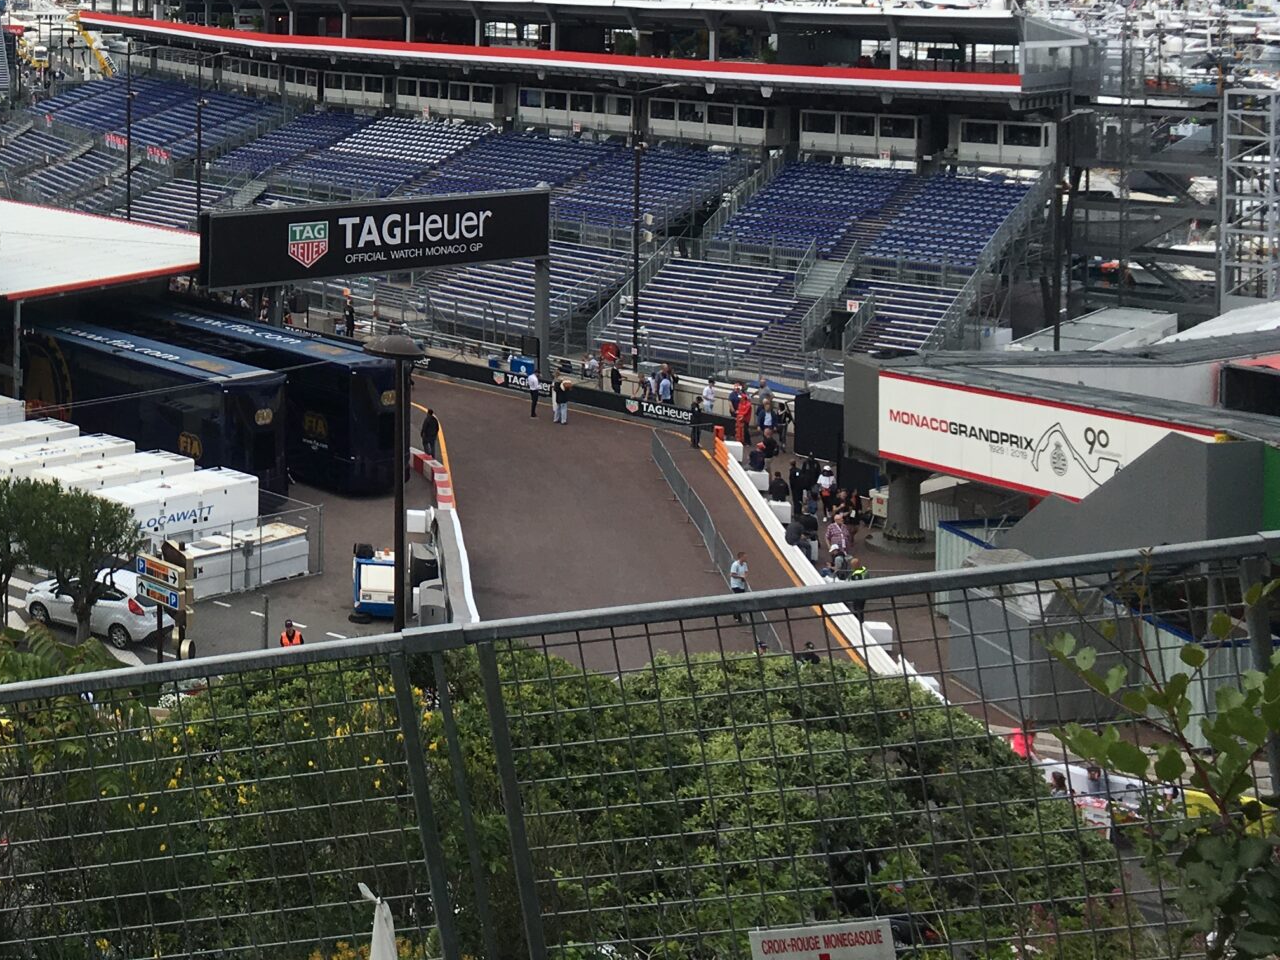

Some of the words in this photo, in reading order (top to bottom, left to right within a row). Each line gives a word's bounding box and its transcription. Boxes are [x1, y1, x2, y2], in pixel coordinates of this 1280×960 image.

[292, 225, 326, 240] TAG
[338, 209, 493, 249] TAGHeuer
[290, 240, 327, 264] HEUER
[345, 251, 387, 264] OFFICIAL
[390, 248, 422, 260] WATCH
[425, 243, 467, 256] MONACO
[469, 242, 484, 253] GP
[507, 374, 551, 392] TAGer
[641, 402, 693, 421] TAGHeuer
[305, 415, 327, 434] FIA
[889, 408, 1035, 452] MONACOGRANDPRIX
[181, 435, 201, 455] FIA
[1083, 426, 1110, 455] 90
[138, 504, 214, 530] LOCAWATT
[761, 935, 821, 955] CROIX-ROUGE
[824, 929, 884, 949] MONEGASQUE
